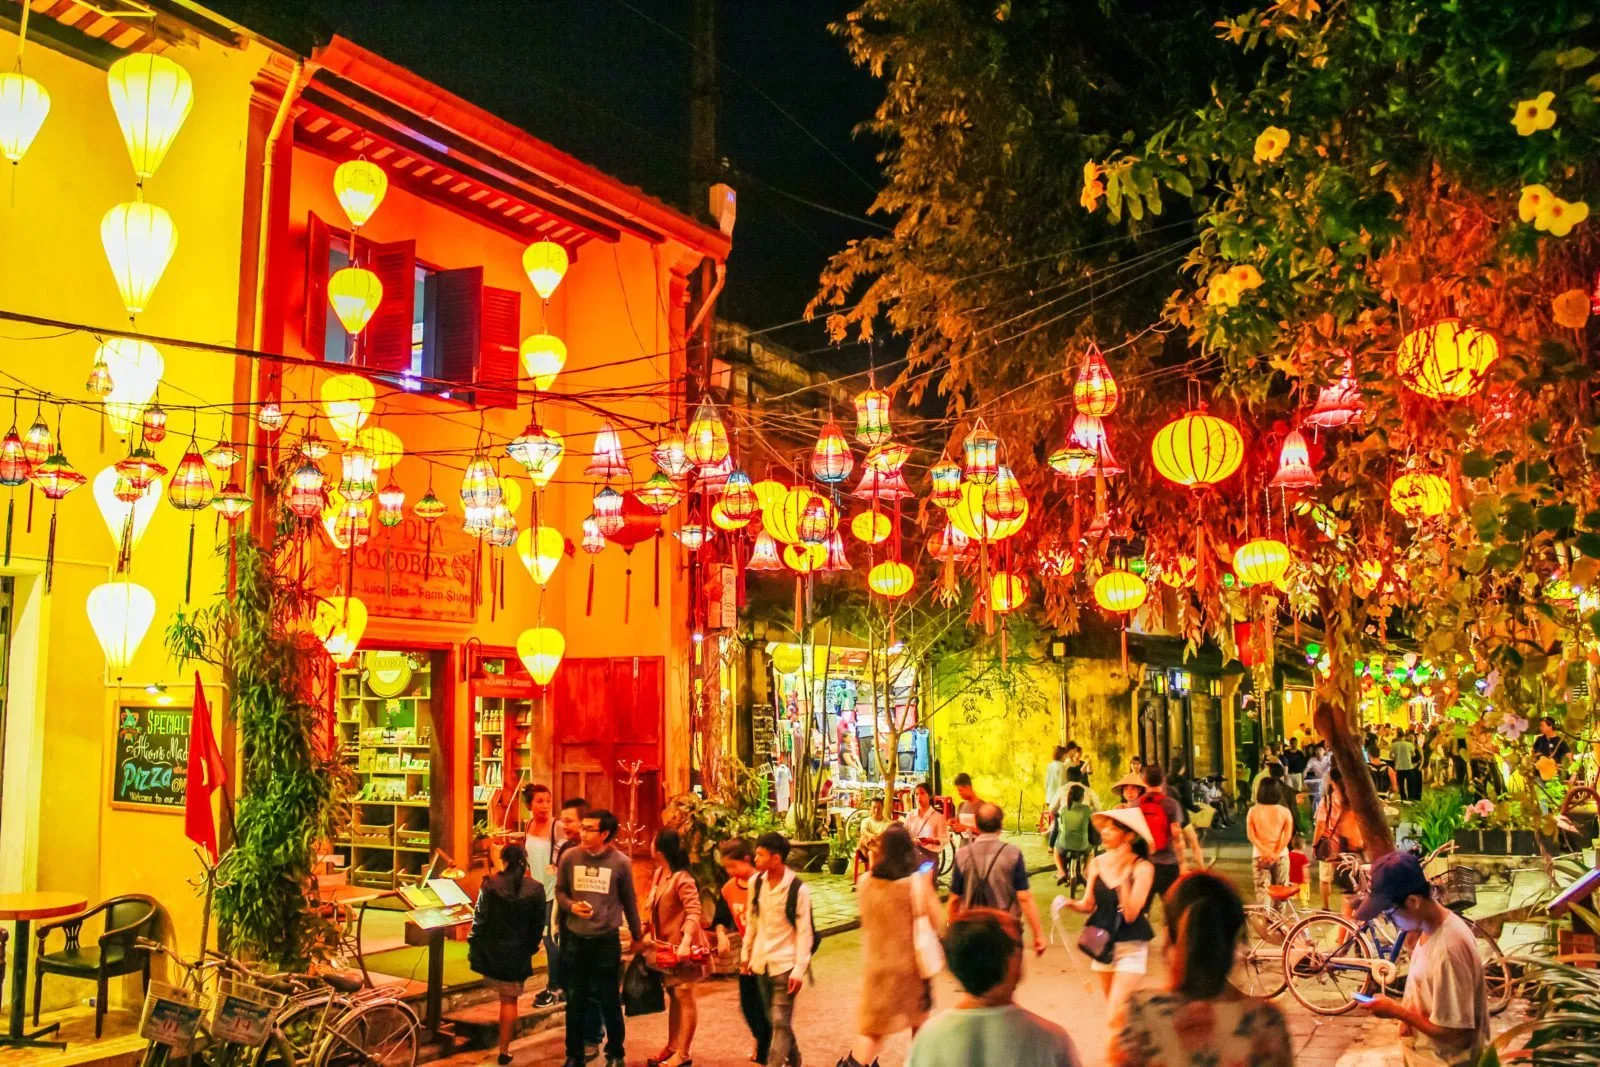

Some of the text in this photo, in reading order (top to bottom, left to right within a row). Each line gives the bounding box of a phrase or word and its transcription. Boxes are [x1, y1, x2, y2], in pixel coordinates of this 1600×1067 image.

[353, 546, 448, 577] COCOBOX
[391, 584, 409, 597] Bar
[418, 586, 444, 600] Farm
[446, 590, 471, 604] Shop
[147, 710, 193, 735] SPECIALT
[166, 737, 188, 763] Mad
[121, 763, 172, 797] Pizza
[129, 792, 152, 803] Welcome
[155, 793, 162, 802] to
